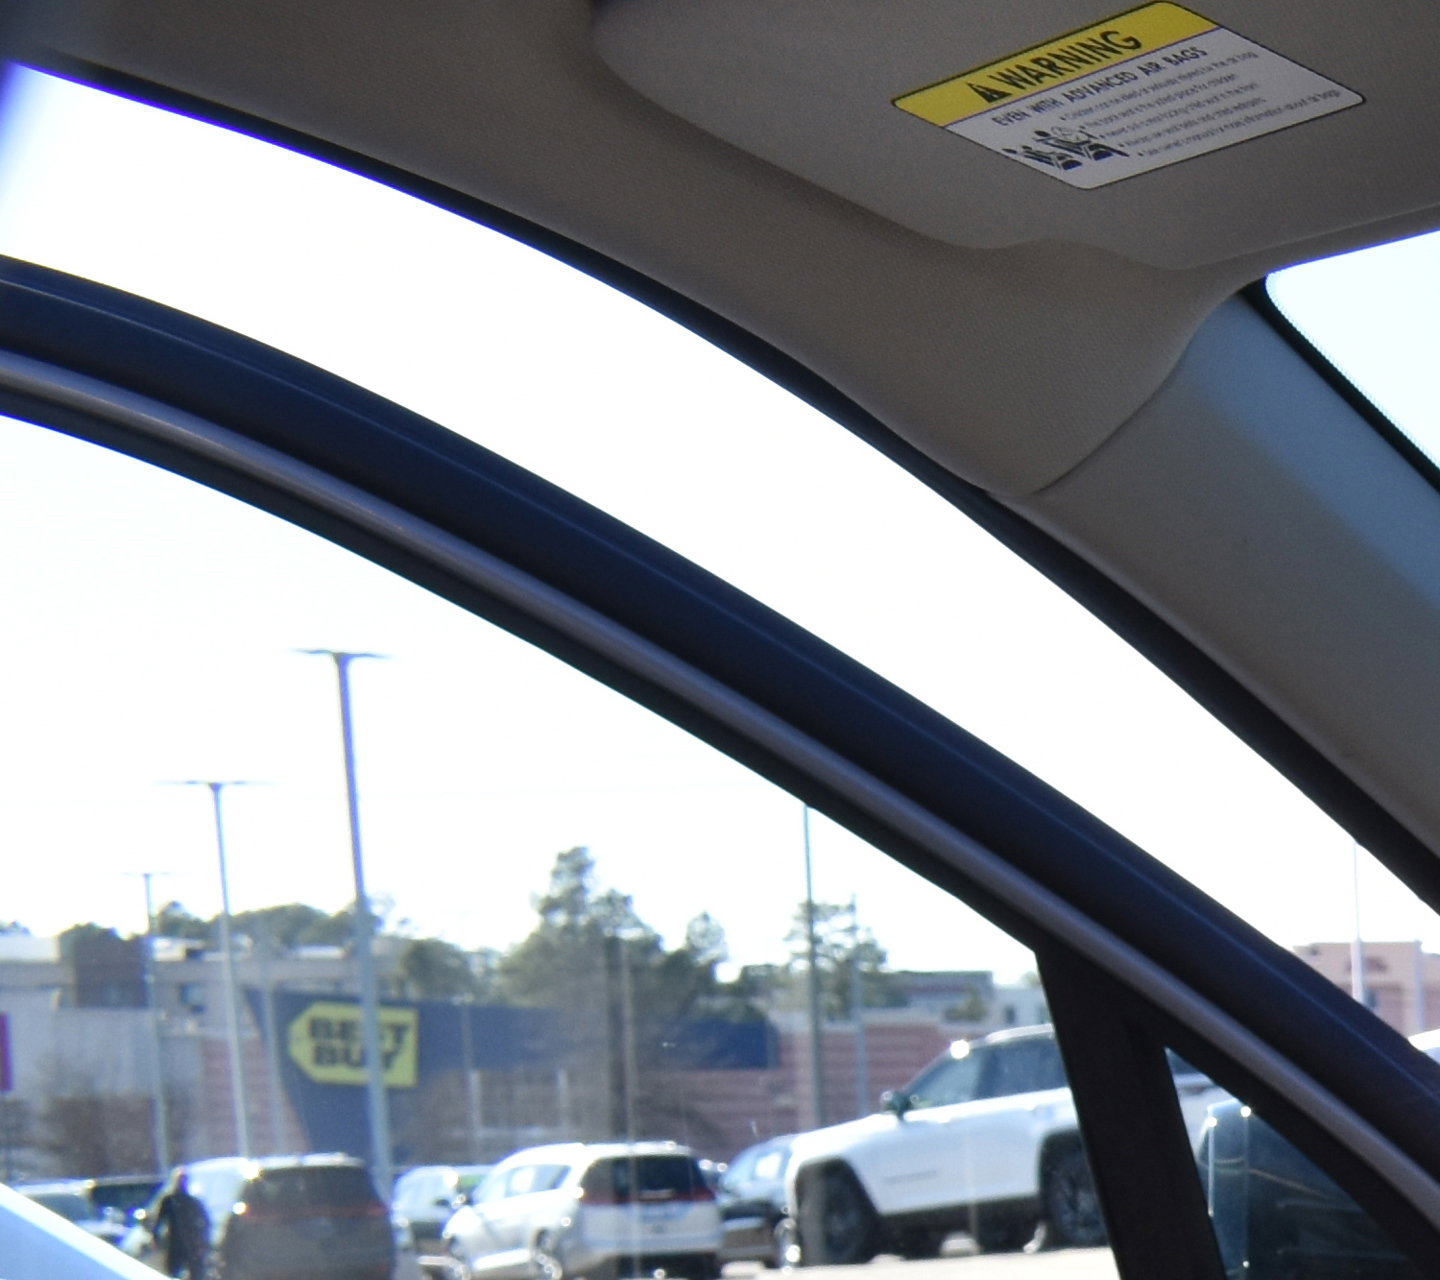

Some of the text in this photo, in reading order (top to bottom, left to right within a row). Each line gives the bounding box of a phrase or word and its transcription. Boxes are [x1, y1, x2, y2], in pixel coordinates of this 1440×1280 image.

[989, 30, 1143, 90] WARNING
[992, 108, 1032, 127] EVEN
[1062, 71, 1139, 104] ADVANCED
[1136, 61, 1166, 77] AIR
[1162, 46, 1209, 67] BAGS
